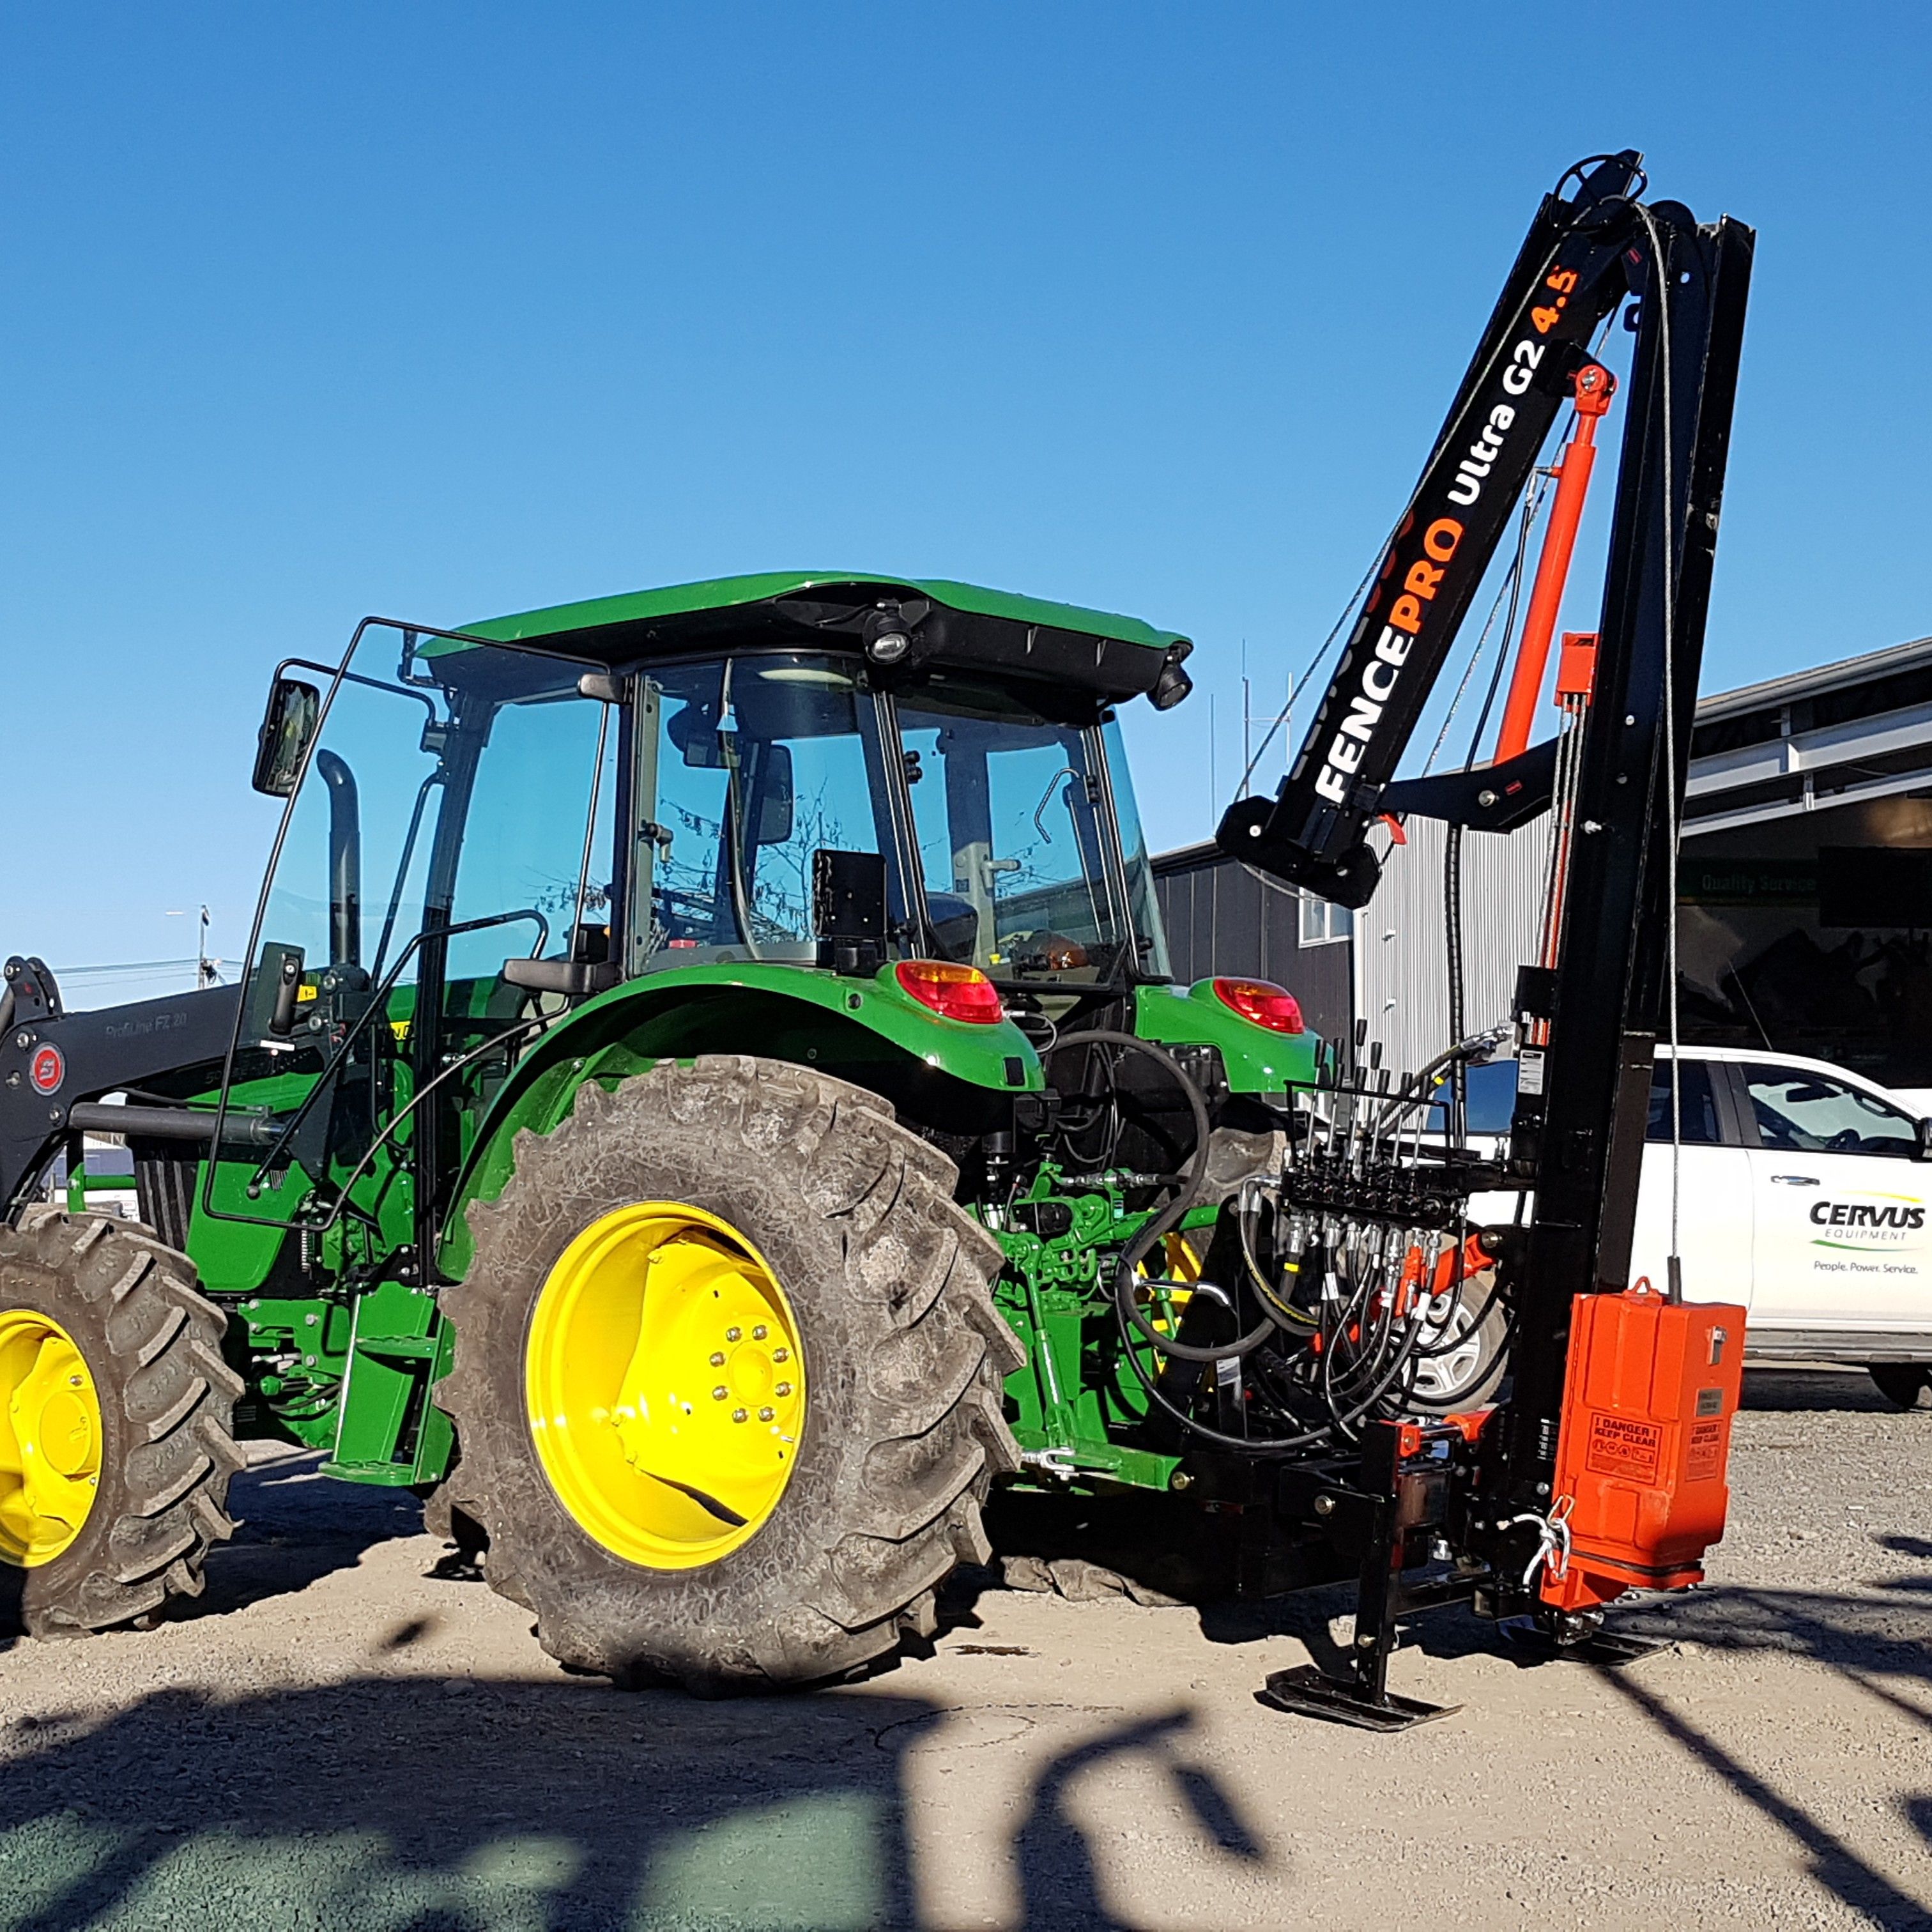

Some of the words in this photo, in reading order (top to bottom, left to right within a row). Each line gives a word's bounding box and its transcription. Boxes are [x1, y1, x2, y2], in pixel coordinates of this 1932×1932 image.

[1314, 518, 1464, 804] FENCEPRO
[1448, 404, 1515, 505] Ultra
[1503, 339, 1545, 395] G2
[1531, 263, 1577, 334] 4.5
[1702, 875, 1755, 894] Quality
[1809, 1201, 1925, 1229] CERVUS
[1824, 1228, 1906, 1241] EQUIPMENT
[1814, 1260, 1848, 1272] People.
[1882, 1263, 1919, 1275] Service.
[1602, 1418, 1650, 1437] DANGER
[1595, 1427, 1621, 1439] KEEP
[1623, 1433, 1656, 1448] CLEAR
